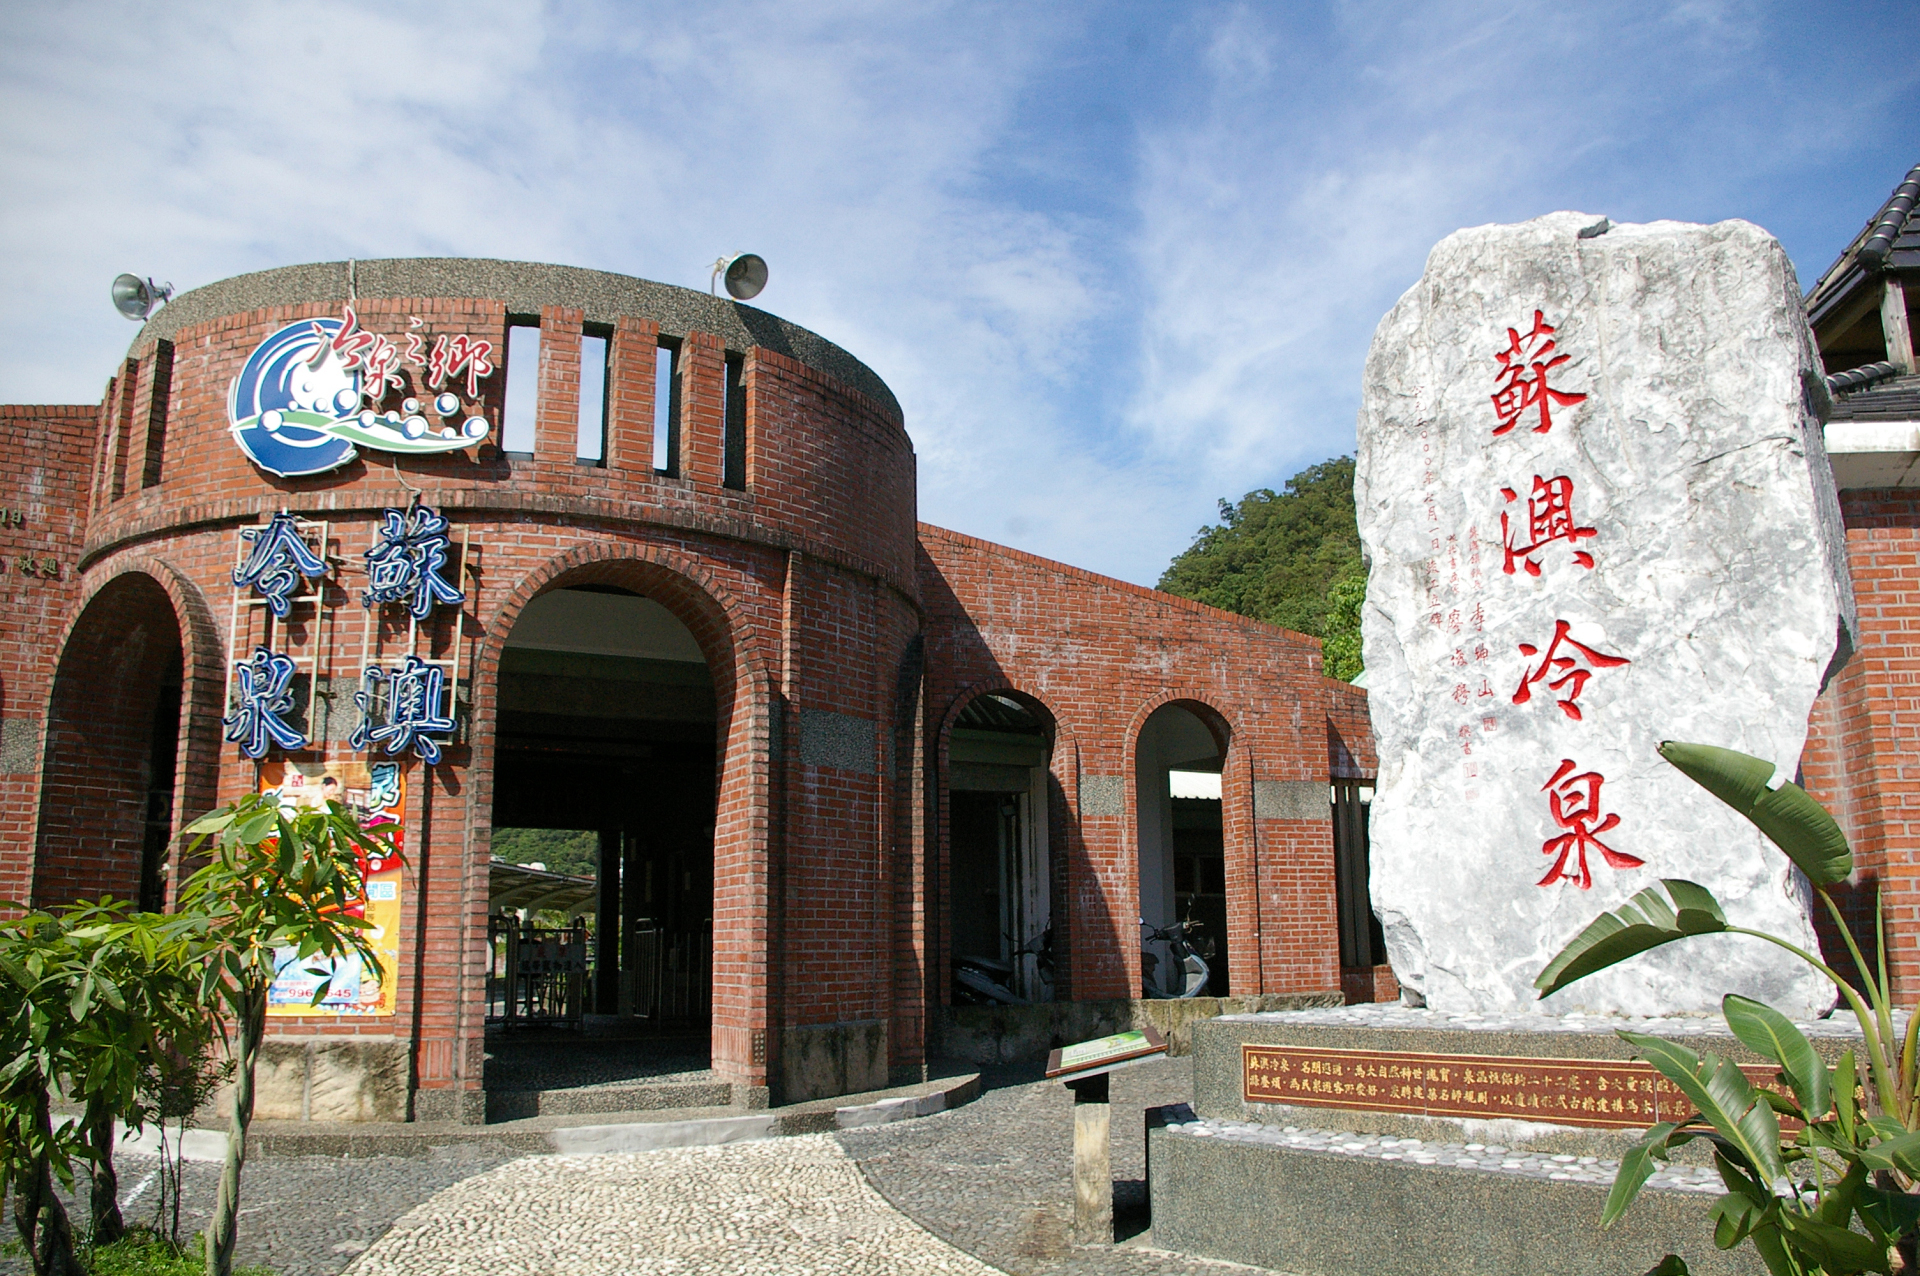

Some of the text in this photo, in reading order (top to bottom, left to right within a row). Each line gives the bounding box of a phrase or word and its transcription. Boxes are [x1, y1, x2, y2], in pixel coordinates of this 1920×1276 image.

[306, 306, 493, 397] 冷泉之鄉
[223, 513, 329, 759] 冷泉
[350, 506, 466, 765] 蘇澳
[1490, 309, 1645, 890] 蘇澳冷泉
